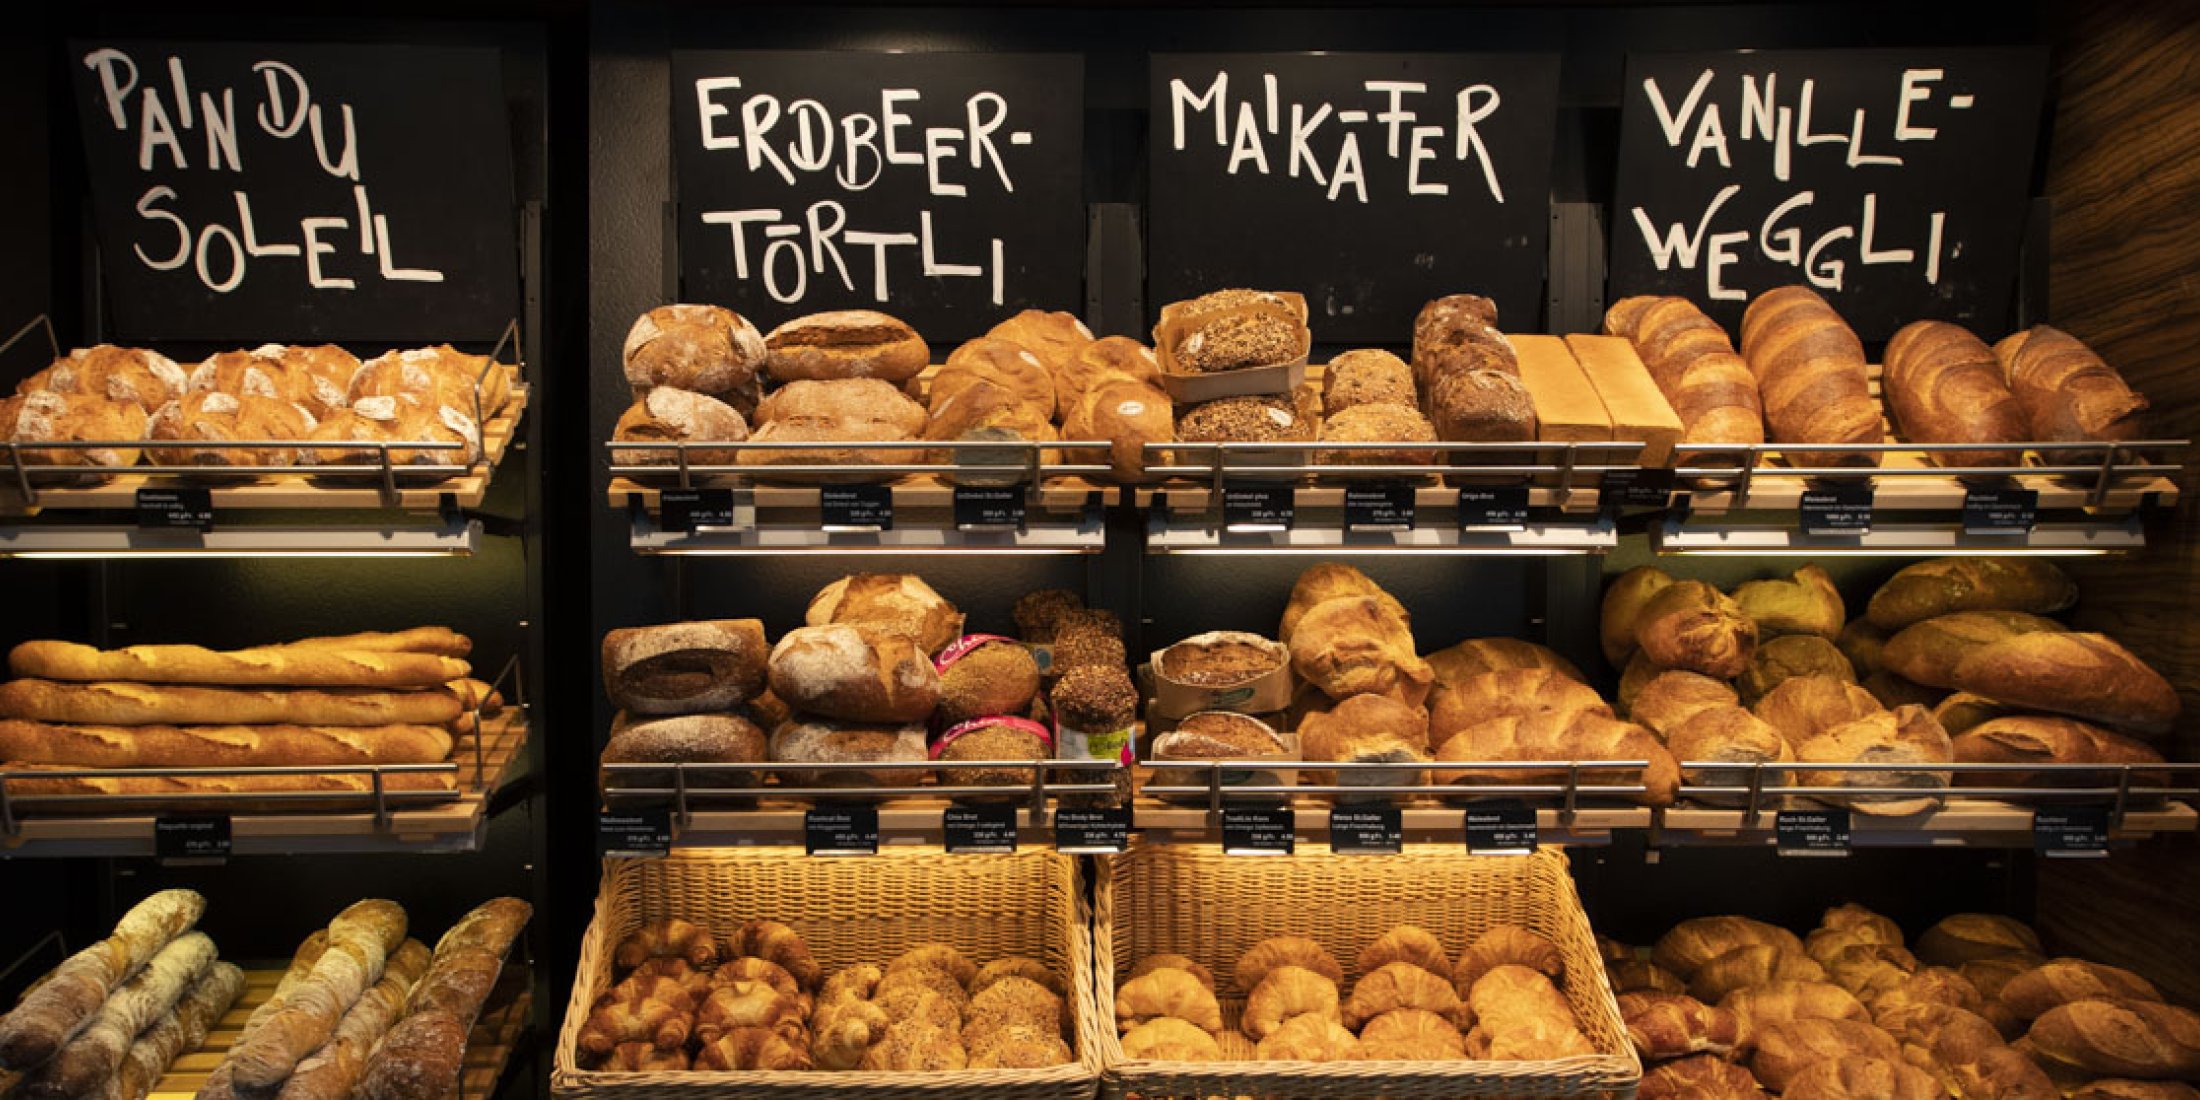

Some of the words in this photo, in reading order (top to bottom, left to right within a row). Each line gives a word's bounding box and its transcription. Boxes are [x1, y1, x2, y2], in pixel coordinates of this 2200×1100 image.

[84, 48, 242, 172] PAIN
[252, 60, 359, 181] DU
[696, 76, 1032, 197] ERDBEER-
[1643, 68, 1974, 181] VANILLE-
[134, 185, 443, 292] SOLEIL
